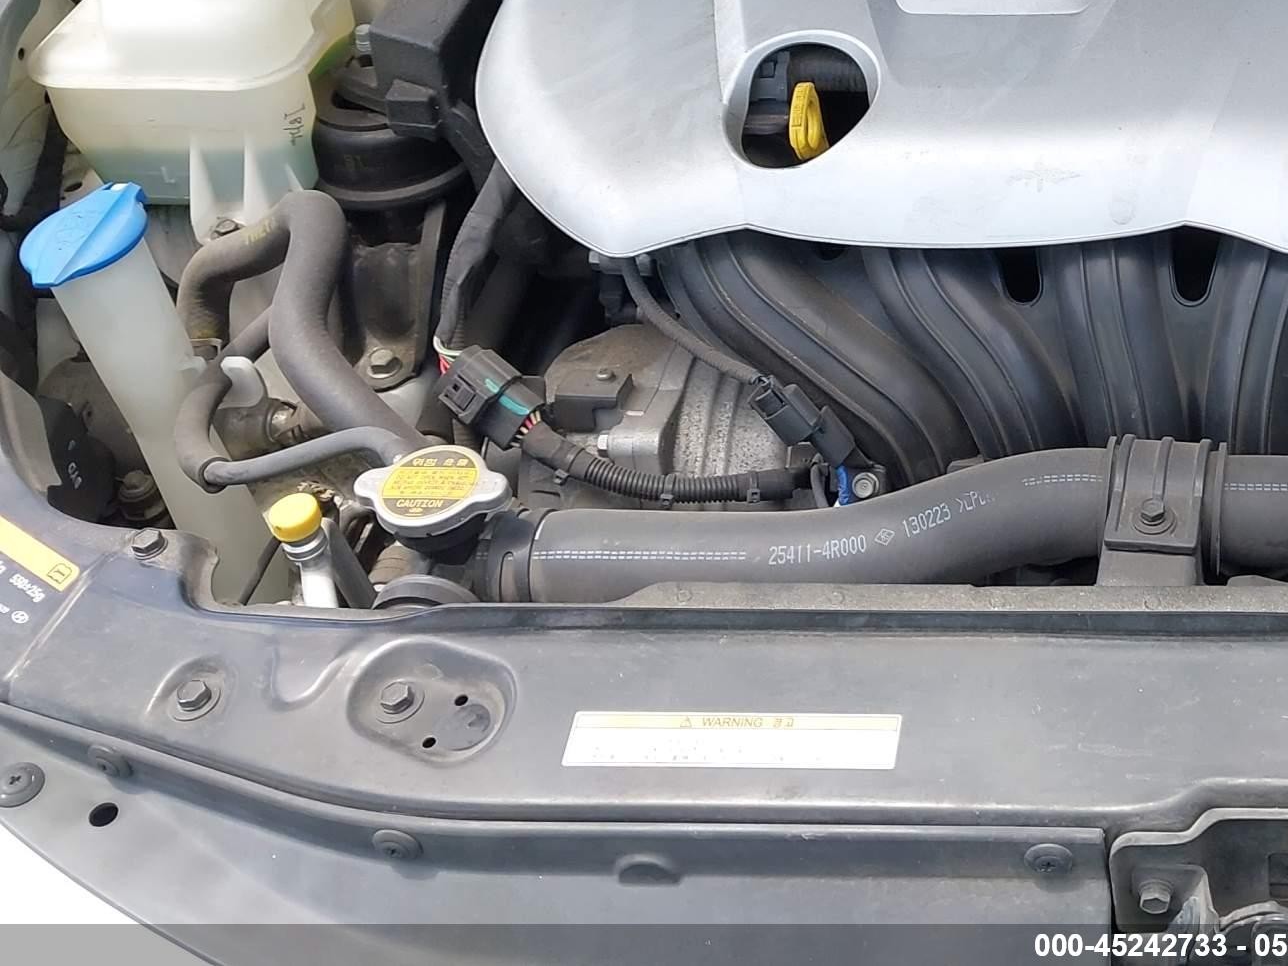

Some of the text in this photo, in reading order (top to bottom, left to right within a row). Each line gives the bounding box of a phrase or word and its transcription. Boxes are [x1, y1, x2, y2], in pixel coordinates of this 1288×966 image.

[396, 499, 443, 509] CAUTION
[767, 534, 867, 566] 25411-4R000
[902, 502, 951, 539] 130223
[701, 716, 763, 728] WARNING
